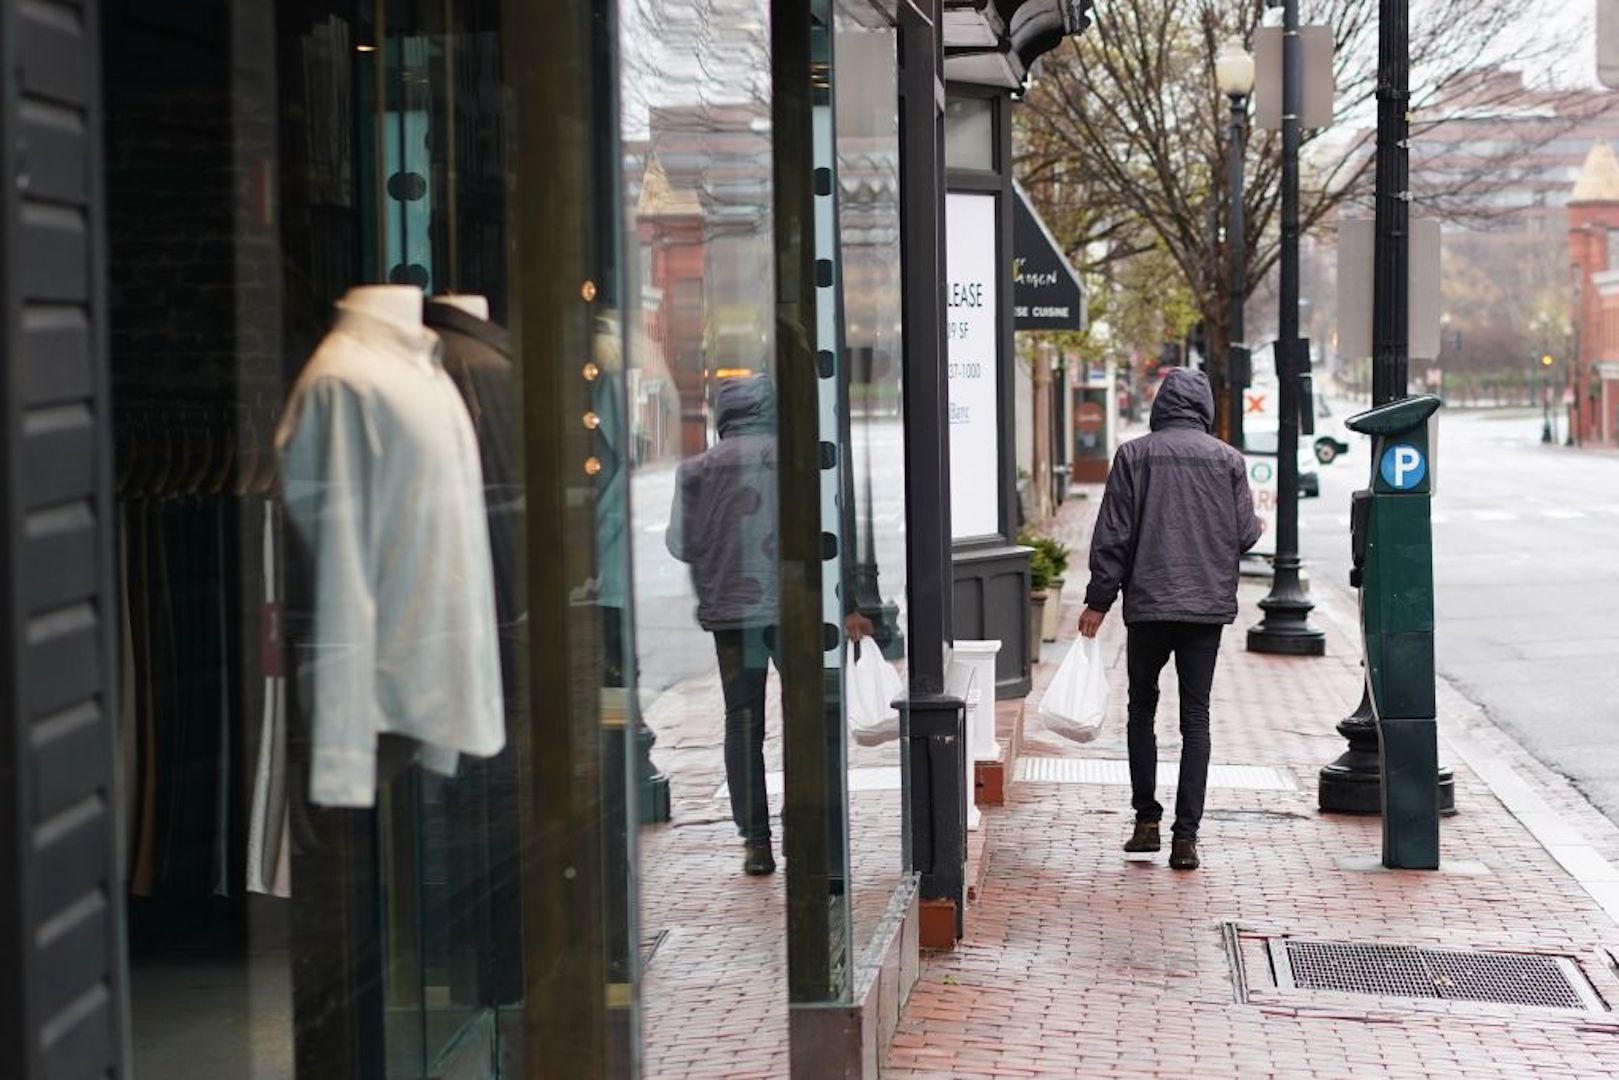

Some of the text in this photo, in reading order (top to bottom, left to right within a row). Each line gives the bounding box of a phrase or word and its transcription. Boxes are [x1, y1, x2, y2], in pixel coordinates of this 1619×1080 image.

[947, 283, 982, 307] LEASE
[1031, 306, 1069, 318] CUISINE
[959, 322, 969, 338] SF
[1394, 447, 1421, 488] P
